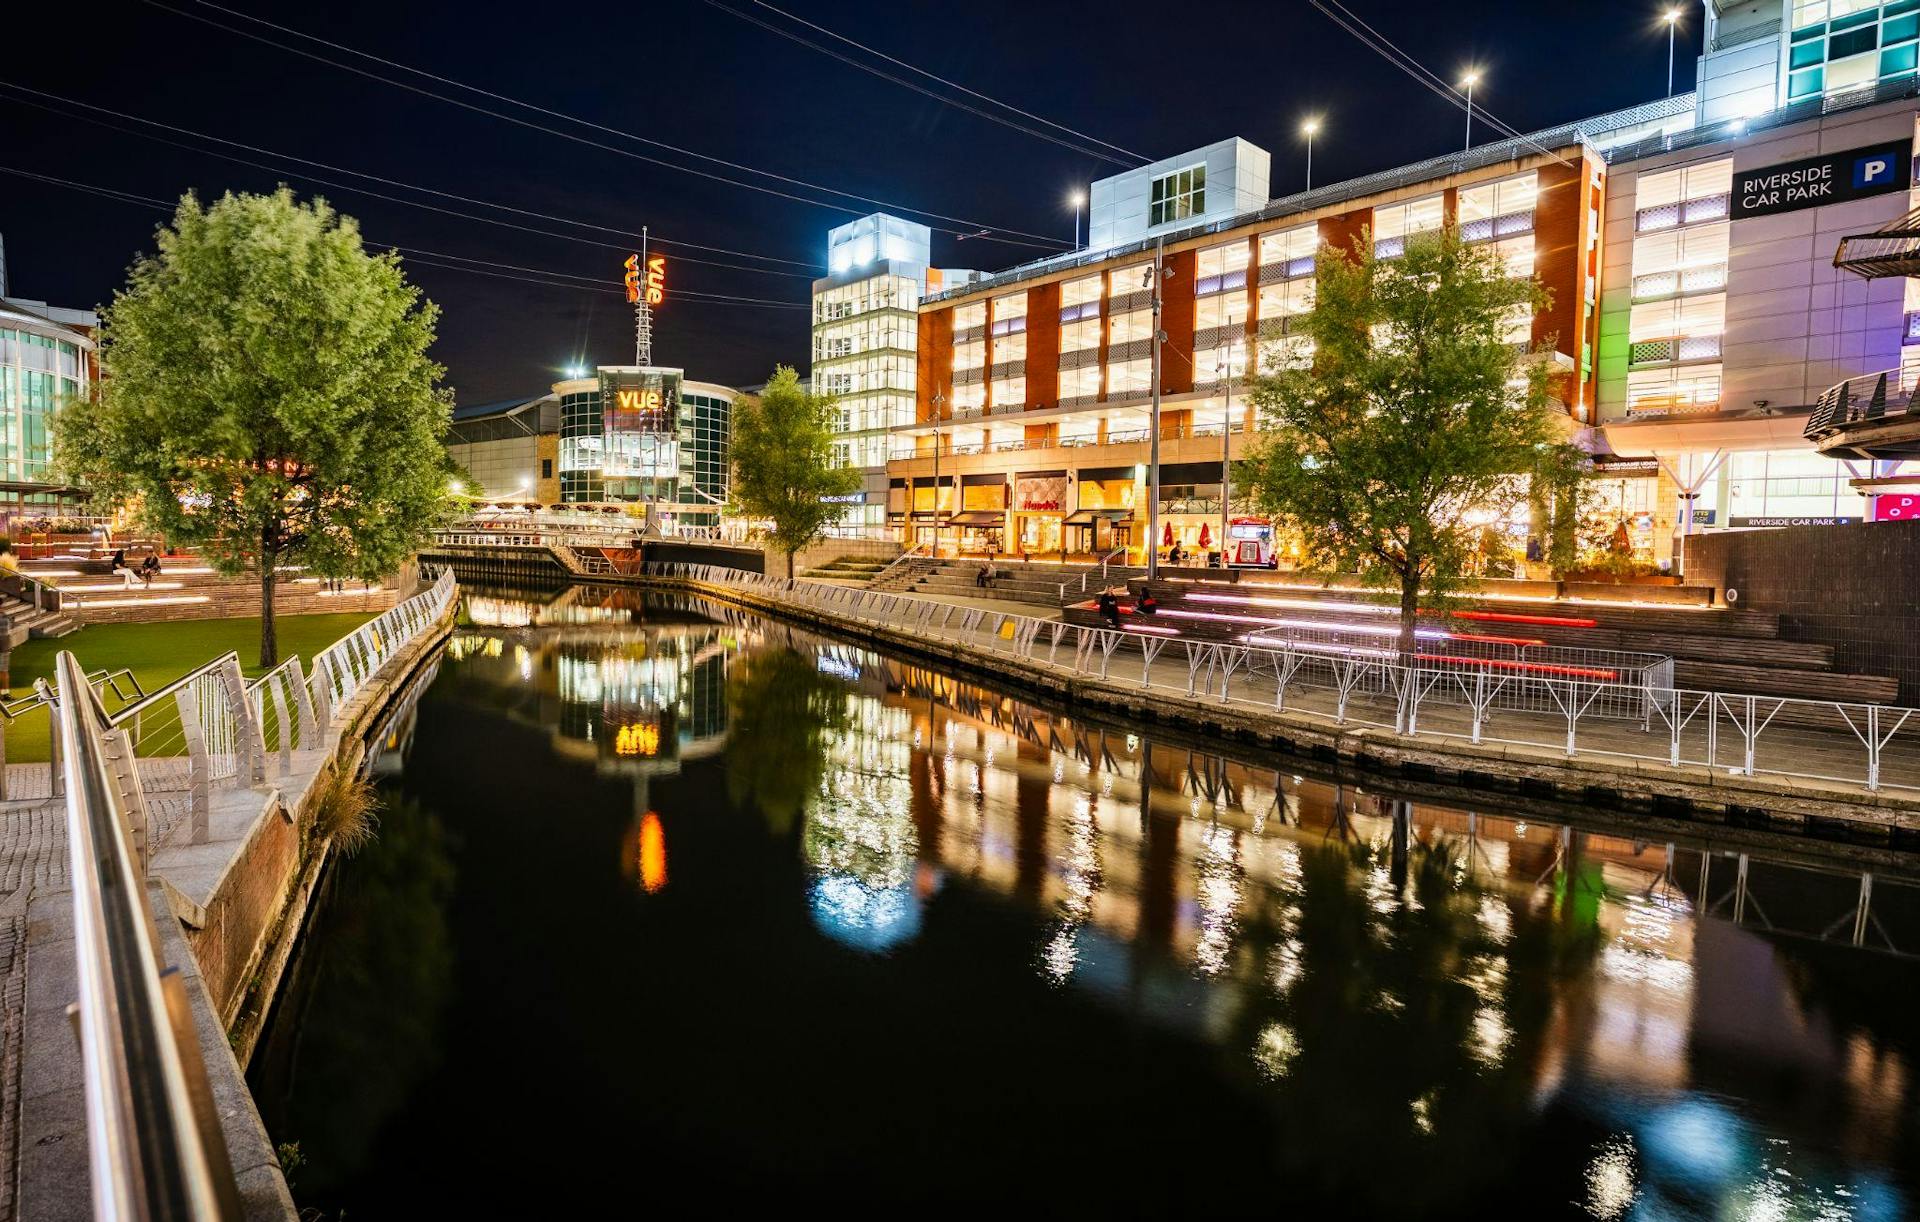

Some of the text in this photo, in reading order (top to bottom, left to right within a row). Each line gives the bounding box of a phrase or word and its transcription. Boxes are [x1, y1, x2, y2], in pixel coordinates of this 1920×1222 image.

[1743, 164, 1832, 194] RIVERSIDE
[1864, 160, 1886, 182] P
[1742, 181, 1832, 209] CAR PARK
[646, 258, 665, 304] vue
[619, 391, 659, 409] vue
[1748, 518, 1790, 526] RIVERSIDE
[1791, 518, 1810, 526] CAR
[1813, 518, 1835, 526] PARK
